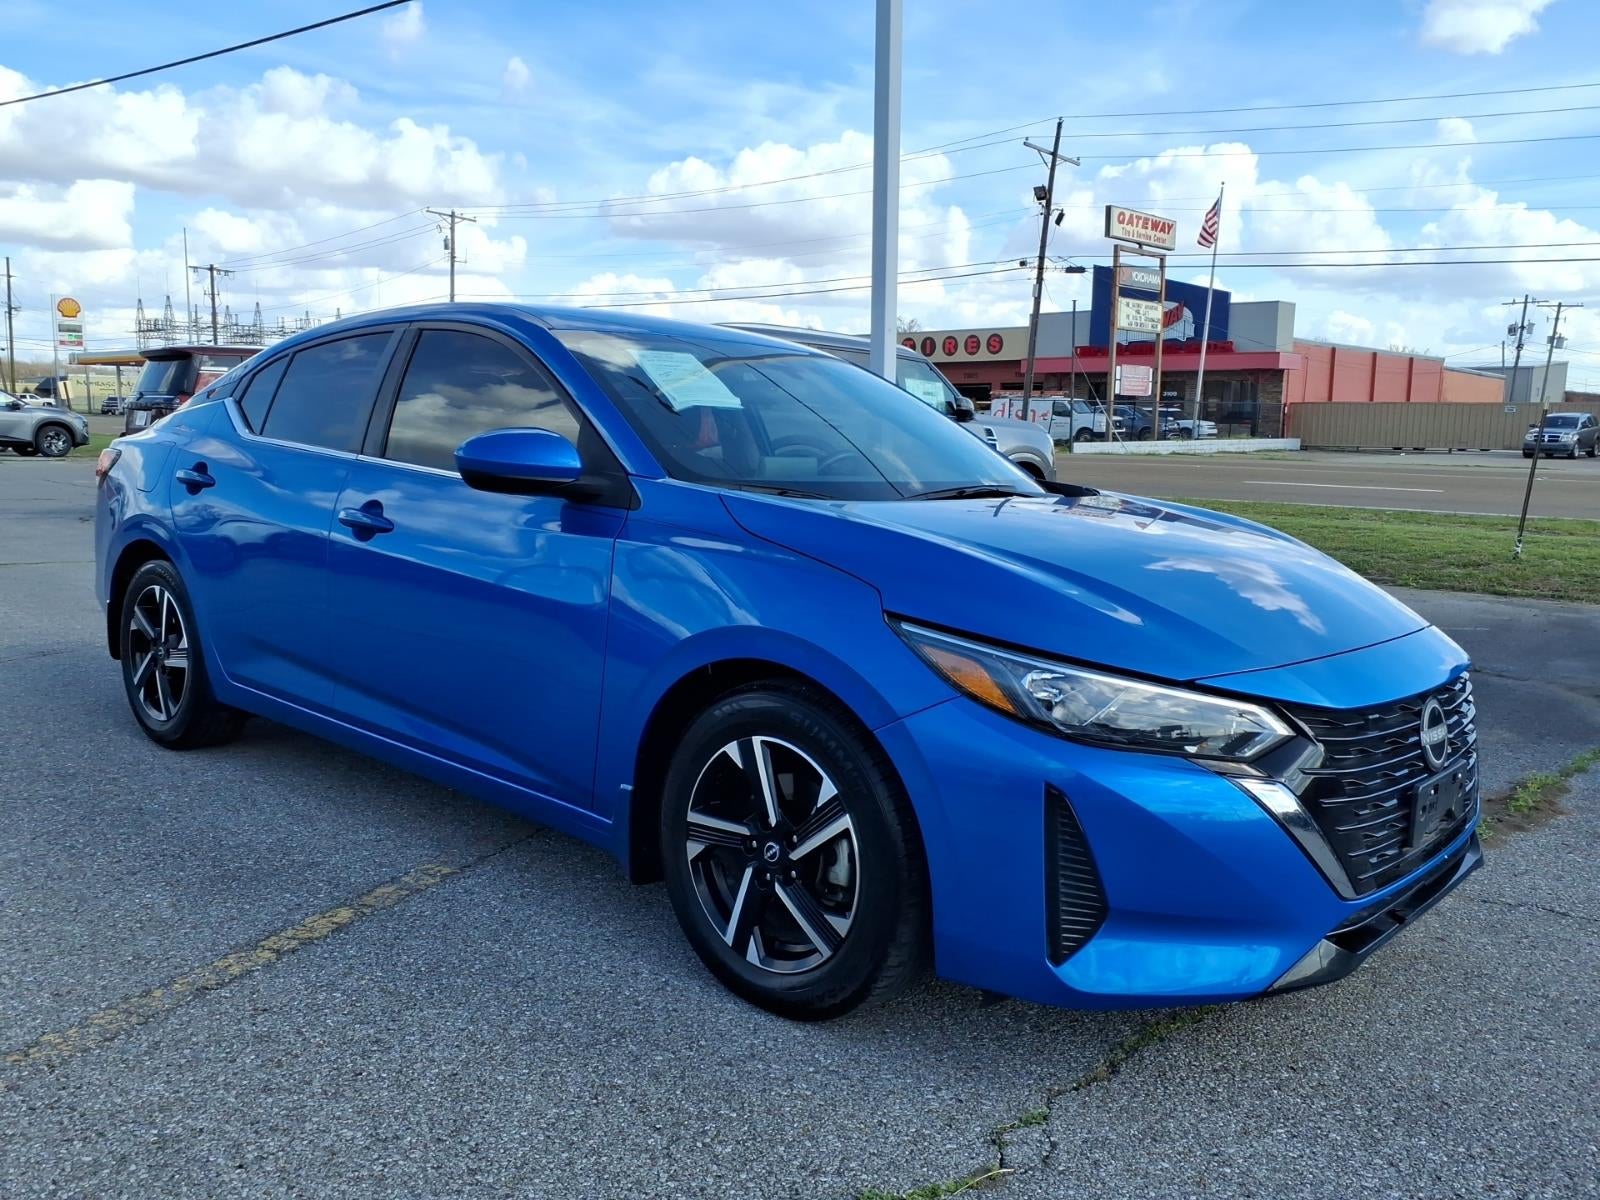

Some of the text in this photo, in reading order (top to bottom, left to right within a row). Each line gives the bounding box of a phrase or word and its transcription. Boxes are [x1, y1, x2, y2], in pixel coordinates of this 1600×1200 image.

[1117, 211, 1174, 235] GATEWAY
[1131, 271, 1161, 284] YOKOHAMA
[903, 334, 1002, 355] TIRES
[1422, 726, 1445, 744] NISS
